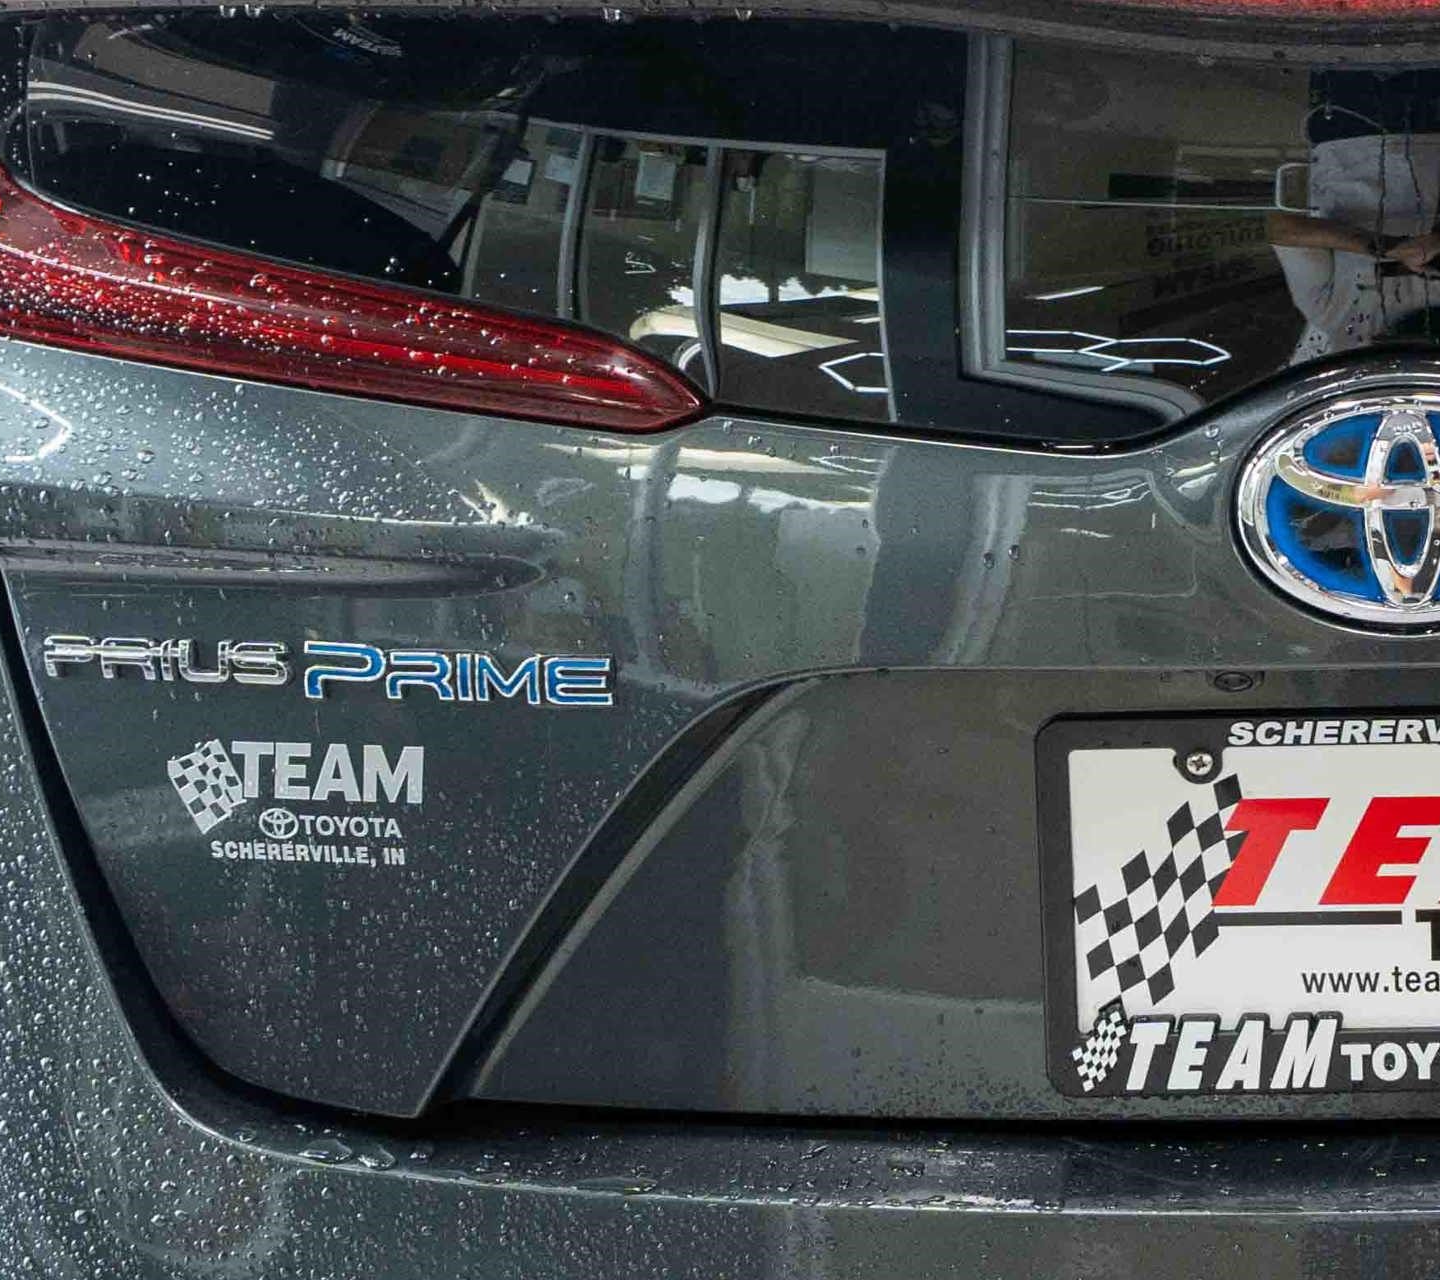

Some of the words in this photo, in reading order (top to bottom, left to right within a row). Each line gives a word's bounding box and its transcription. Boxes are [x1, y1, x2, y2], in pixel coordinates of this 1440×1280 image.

[43, 634, 289, 685] PRIUS
[304, 640, 614, 706] PRIME
[231, 740, 425, 804] TEAM
[211, 839, 377, 866] SCHERERVILLE,
[382, 846, 405, 865] IN
[299, 814, 402, 839] TOYOTA
[1125, 1018, 1342, 1091] TEAM
